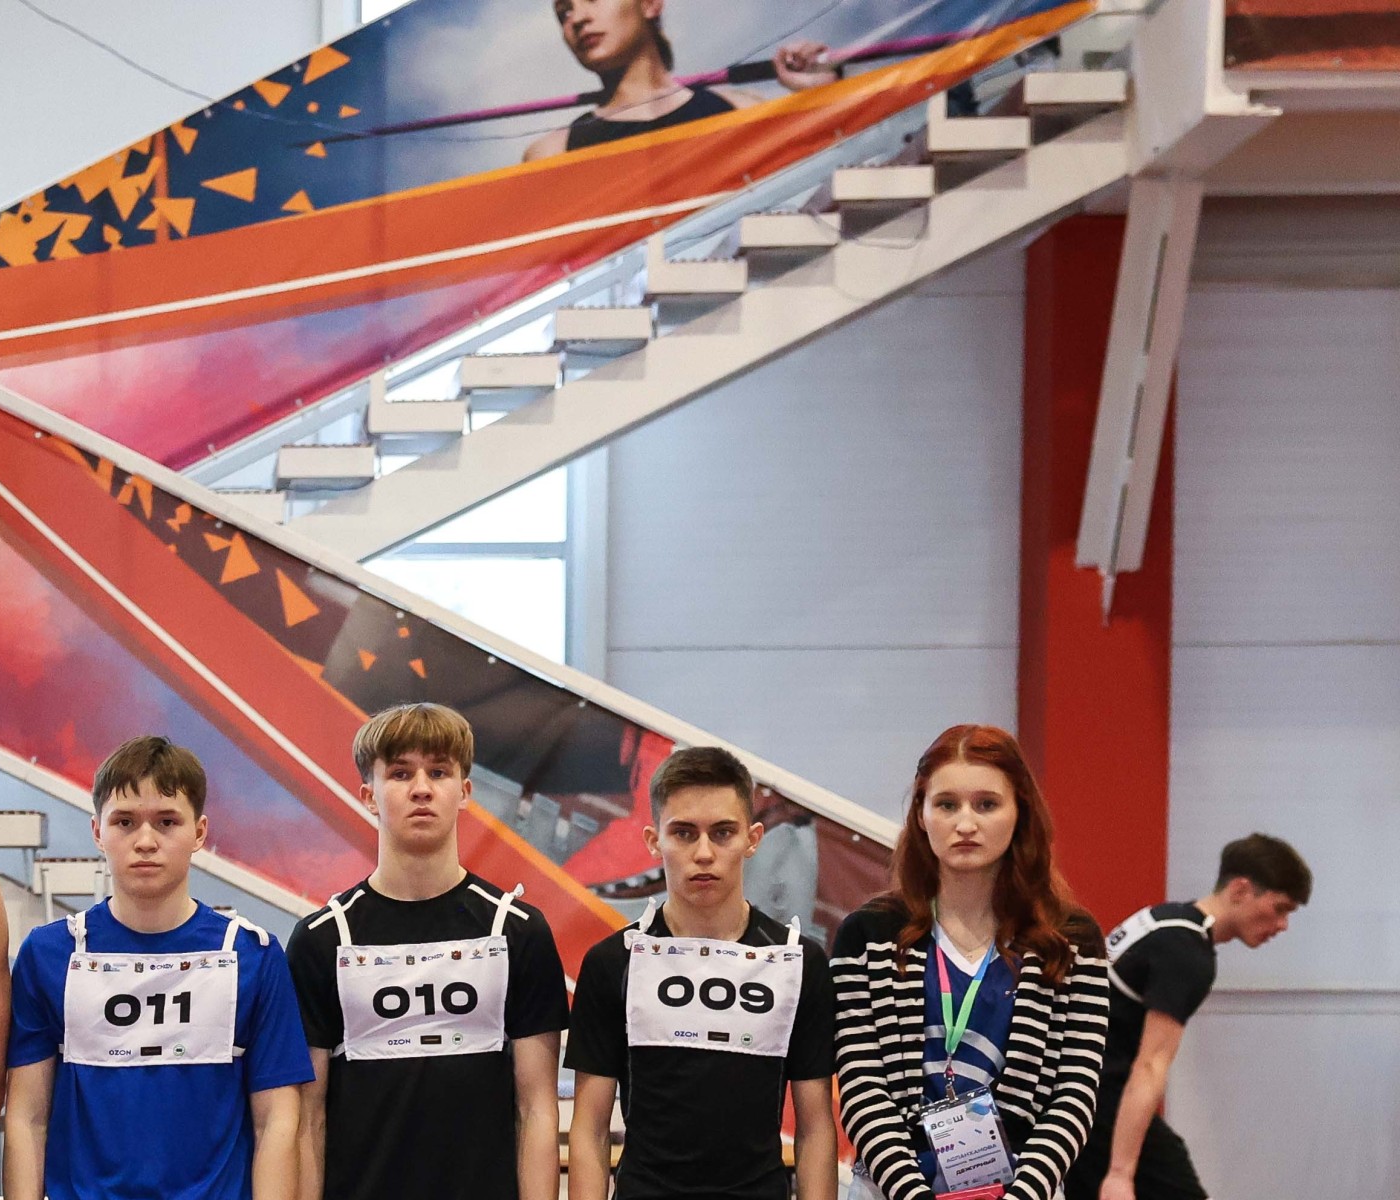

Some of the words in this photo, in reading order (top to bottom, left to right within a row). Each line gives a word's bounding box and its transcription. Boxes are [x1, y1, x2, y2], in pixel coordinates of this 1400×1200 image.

[104, 991, 191, 1026] 011
[373, 982, 478, 1019] 010
[658, 975, 774, 1014] 009
[387, 1038, 411, 1046] OZON
[674, 1030, 699, 1038] OZON
